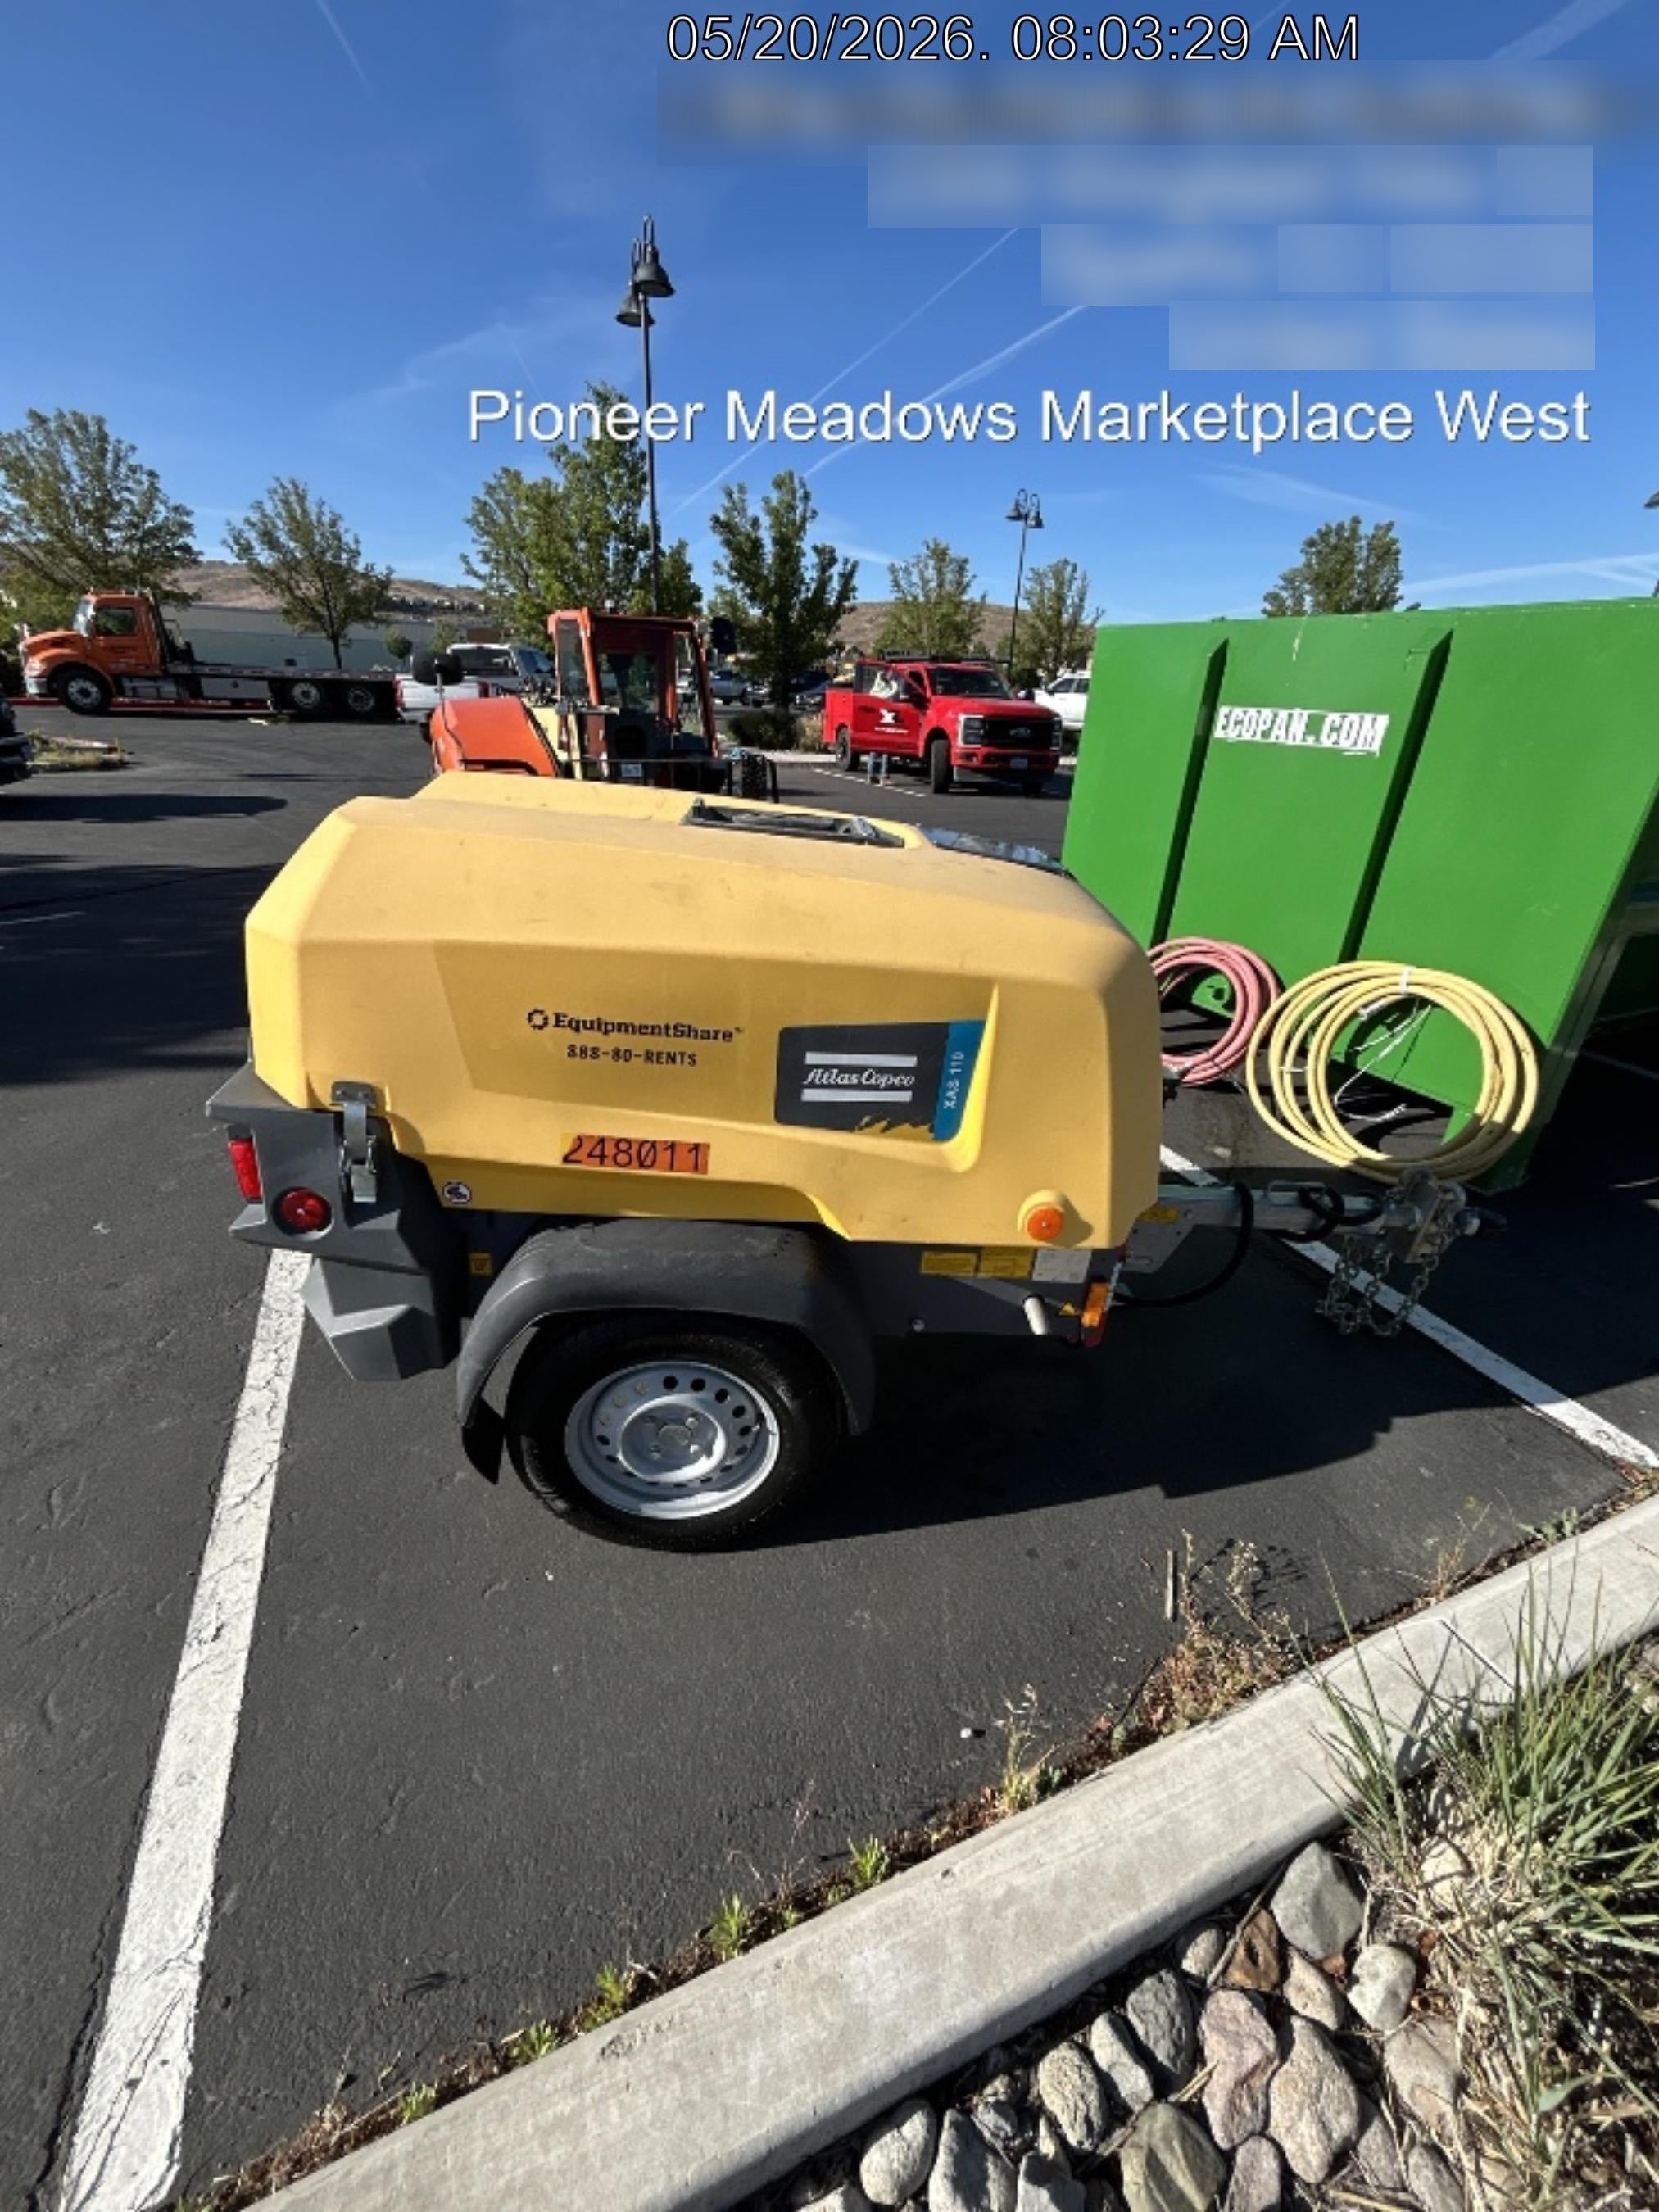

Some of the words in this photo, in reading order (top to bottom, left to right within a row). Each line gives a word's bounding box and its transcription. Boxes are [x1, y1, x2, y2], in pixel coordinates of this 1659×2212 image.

[1213, 706, 1389, 754] ECOPAN.COM
[949, 1051, 965, 1073] 110
[803, 1068, 859, 1086] Atlas
[861, 1068, 915, 1089] Copco
[944, 1080, 960, 1109] XAS
[562, 1135, 702, 1172] 248011
